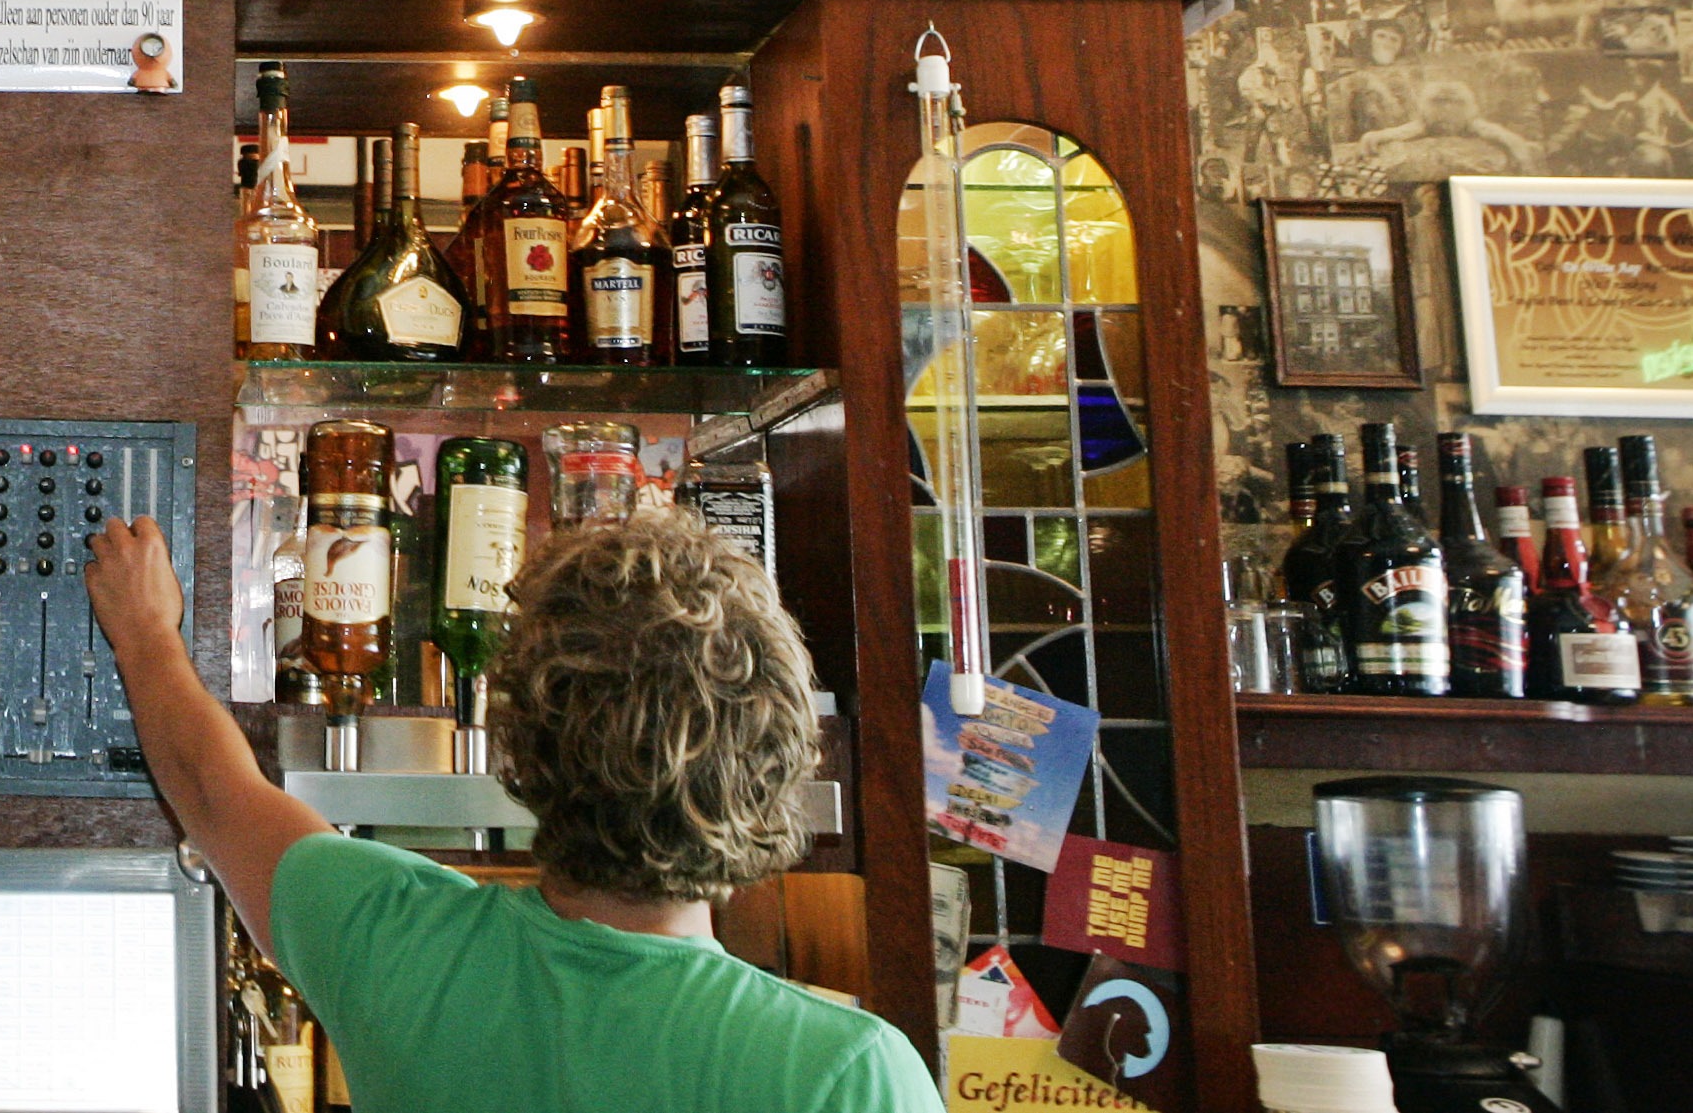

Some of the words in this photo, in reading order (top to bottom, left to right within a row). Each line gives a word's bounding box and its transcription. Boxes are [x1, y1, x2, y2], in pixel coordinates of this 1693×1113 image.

[26, 8, 44, 26] aan
[46, 7, 90, 33] personen
[91, 1, 120, 26] ouder
[121, 1, 140, 26] dan
[141, 1, 155, 26] 90
[155, 1, 175, 32] jaar
[42, 47, 60, 66] van
[732, 227, 782, 243] RICAR
[262, 256, 314, 271] Boulard
[593, 278, 641, 290] MARTELL
[312, 581, 376, 598] GROUSE
[313, 598, 372, 614] FAMOUS
[1661, 626, 1689, 648] 43
[1091, 854, 1113, 887] ME
[1110, 859, 1133, 894] ME
[1131, 856, 1154, 890] ME
[1087, 888, 1111, 936] TAKE
[1107, 896, 1129, 938] USE
[1125, 891, 1150, 948] DUMP
